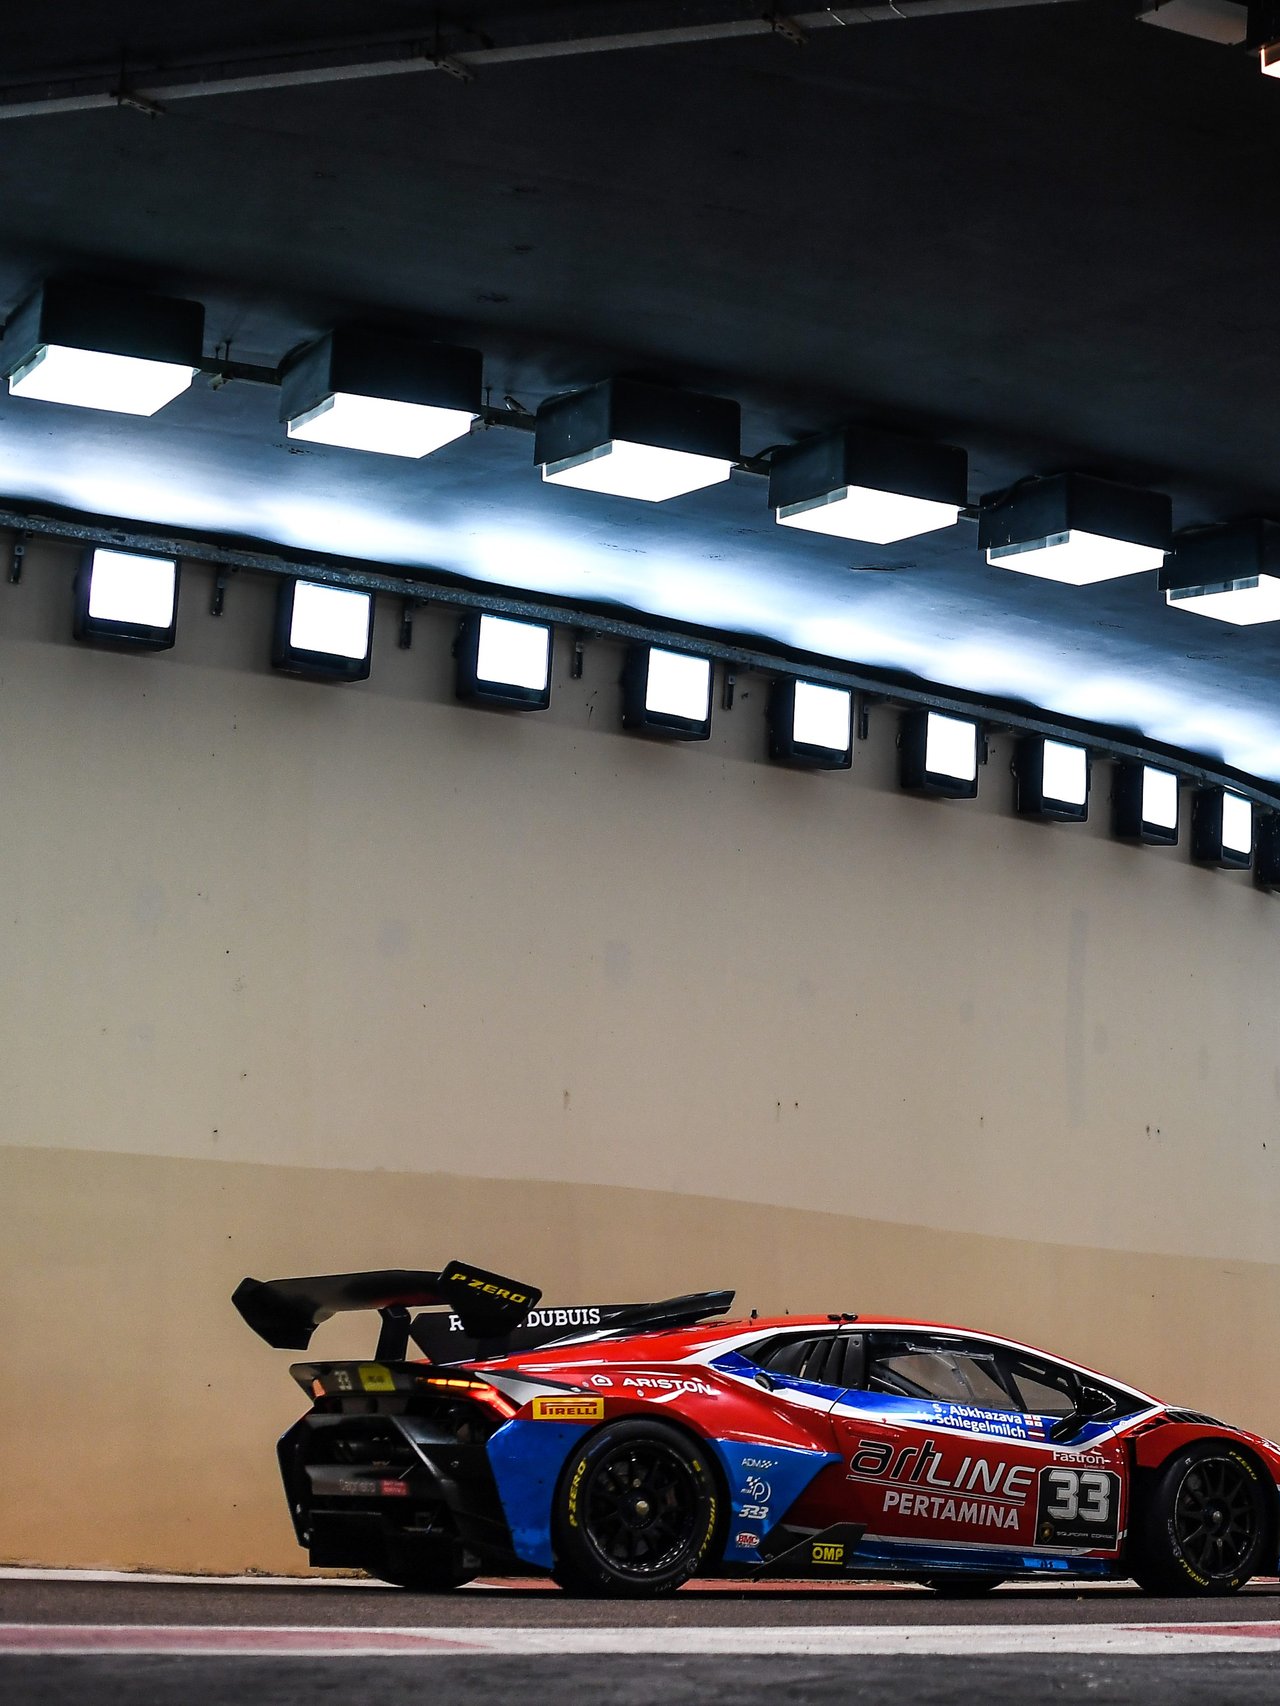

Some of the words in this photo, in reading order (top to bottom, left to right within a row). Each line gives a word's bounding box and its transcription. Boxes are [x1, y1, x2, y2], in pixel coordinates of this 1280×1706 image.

[451, 1273, 467, 1281] P
[468, 1279, 527, 1304] ZERO
[527, 1308, 600, 1328] DUBUIS
[622, 1377, 717, 1397] ARISTON
[540, 1402, 598, 1416] PIRELLI
[933, 1403, 947, 1414] S.
[950, 1405, 1023, 1424] Abkhazava
[936, 1413, 1026, 1439] Schlegelmilch
[1053, 1450, 1105, 1465] Fastron
[1047, 1469, 1111, 1523] 33
[882, 1490, 1020, 1530] PERTAMINA
[812, 1545, 844, 1561] OMP
